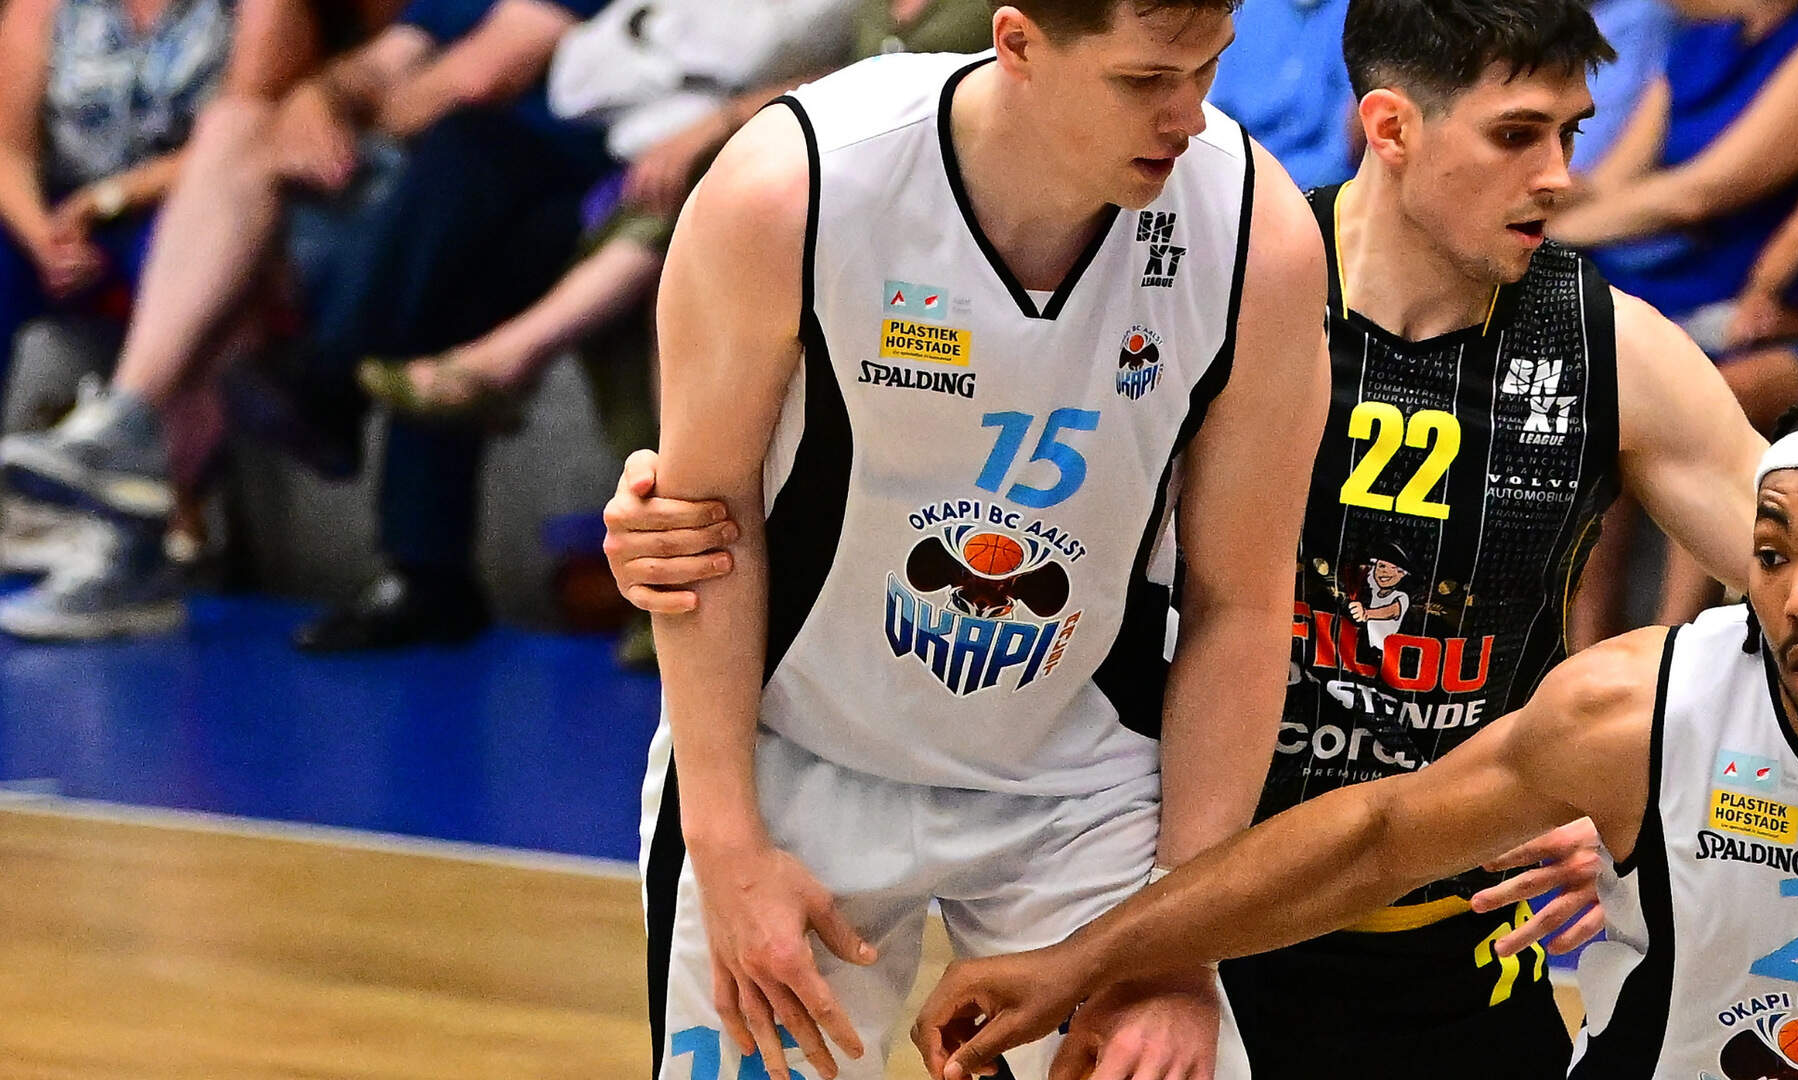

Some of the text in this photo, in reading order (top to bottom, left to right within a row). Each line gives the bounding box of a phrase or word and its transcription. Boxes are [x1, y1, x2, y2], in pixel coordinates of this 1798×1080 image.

[1141, 276, 1174, 288] LEAGUE
[890, 321, 958, 342] PLASTIEK
[885, 335, 961, 356] HOFSTADE
[858, 360, 976, 399] SPALDING
[1518, 432, 1566, 446] LEAGUE
[975, 407, 1101, 509] 15
[1339, 401, 1462, 520] 22
[1488, 473, 1578, 489] VOLVO
[909, 500, 1086, 563] OKAPI BC AALST
[884, 571, 1061, 696] OKAPI
[1720, 792, 1788, 818] PLASTIEK
[1715, 807, 1791, 834] HOFSTADE
[1718, 992, 1790, 1027] OKAPI
